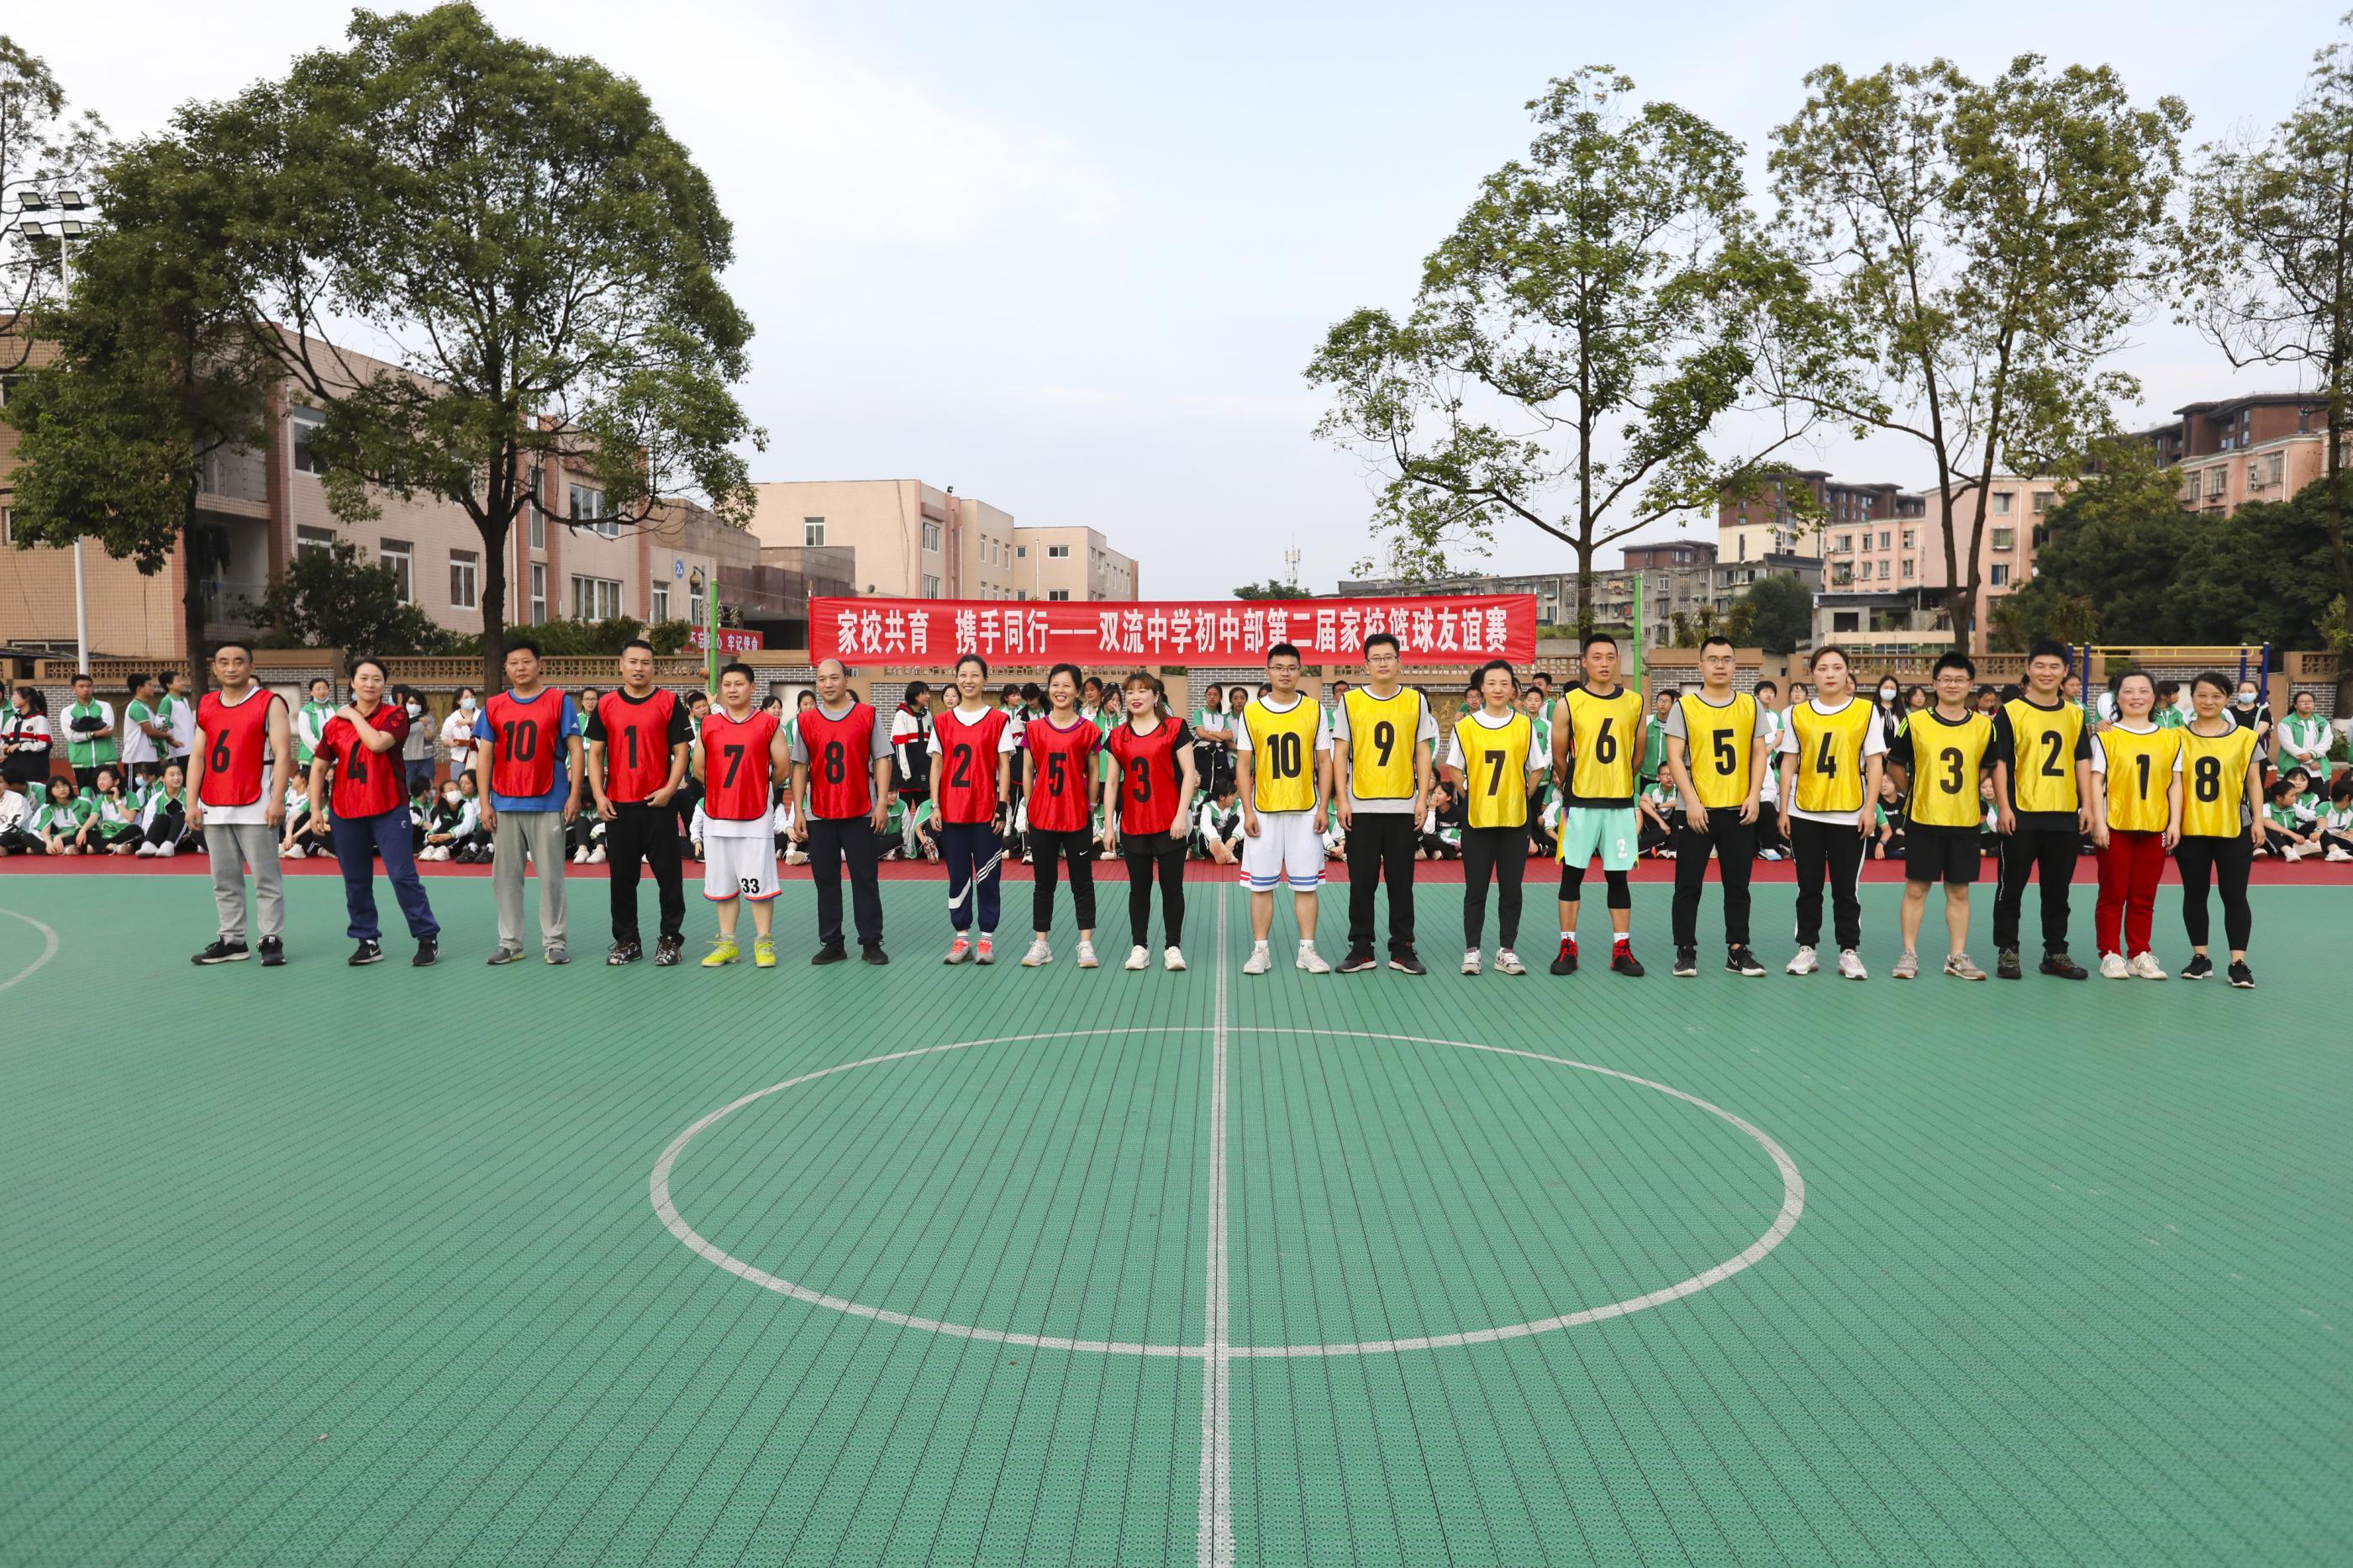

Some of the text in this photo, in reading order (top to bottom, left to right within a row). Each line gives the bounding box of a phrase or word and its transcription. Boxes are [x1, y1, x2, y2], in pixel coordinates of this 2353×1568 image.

[837, 608, 929, 655] 家校共育
[212, 729, 230, 773] 6
[347, 739, 368, 784] 4
[503, 720, 537, 762] 10
[624, 725, 637, 769] 1
[824, 740, 845, 785] 8
[1266, 731, 1302, 780] 10
[1374, 721, 1395, 766] 9
[1595, 718, 1617, 765] 6
[1713, 729, 1736, 776] 5
[1816, 732, 1837, 779] 4
[2040, 730, 2065, 777] 2
[724, 745, 745, 788] 7
[951, 744, 972, 787] 2
[1048, 752, 1067, 797] 5
[1130, 756, 1151, 803] 3
[1485, 750, 1506, 796] 7
[1940, 747, 1964, 795] 3
[2136, 754, 2150, 801] 1
[2194, 755, 2221, 802] 8
[1616, 838, 1628, 859] 2
[740, 877, 760, 894] 33
